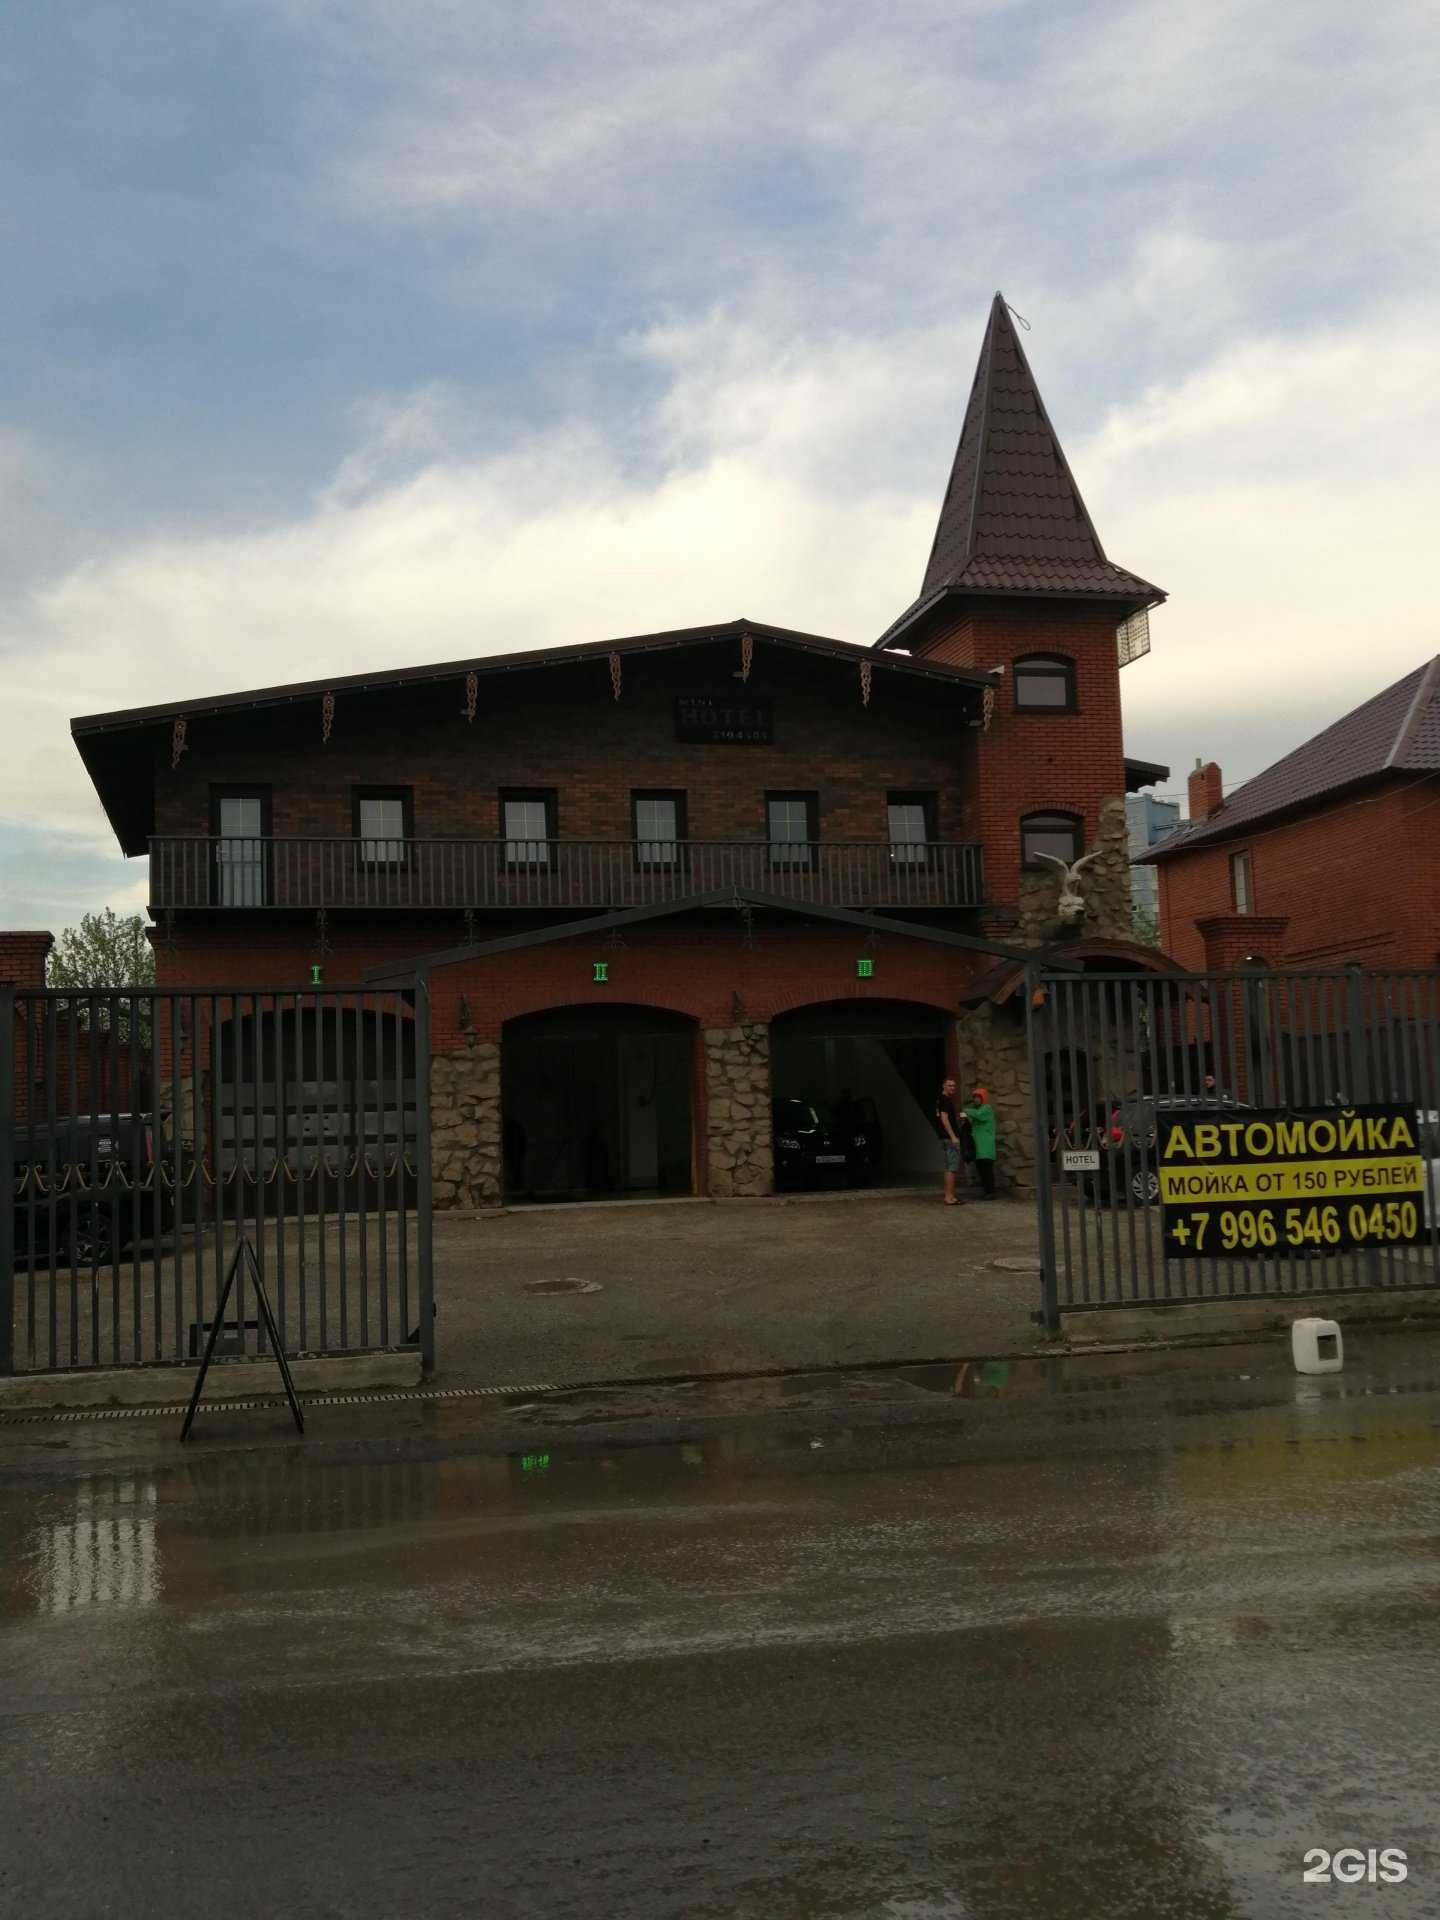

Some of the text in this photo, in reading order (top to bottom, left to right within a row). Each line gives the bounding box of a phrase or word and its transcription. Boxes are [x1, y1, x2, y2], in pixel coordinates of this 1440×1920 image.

[1163, 1110, 1416, 1159] АВТОМОЙКА
[1065, 1155, 1096, 1165] HOTEL
[1168, 1162, 1417, 1196] МОЙКА ОТ 150 РУБЛЕЙ
[1171, 1200, 1418, 1250] +7 996 546 0450
